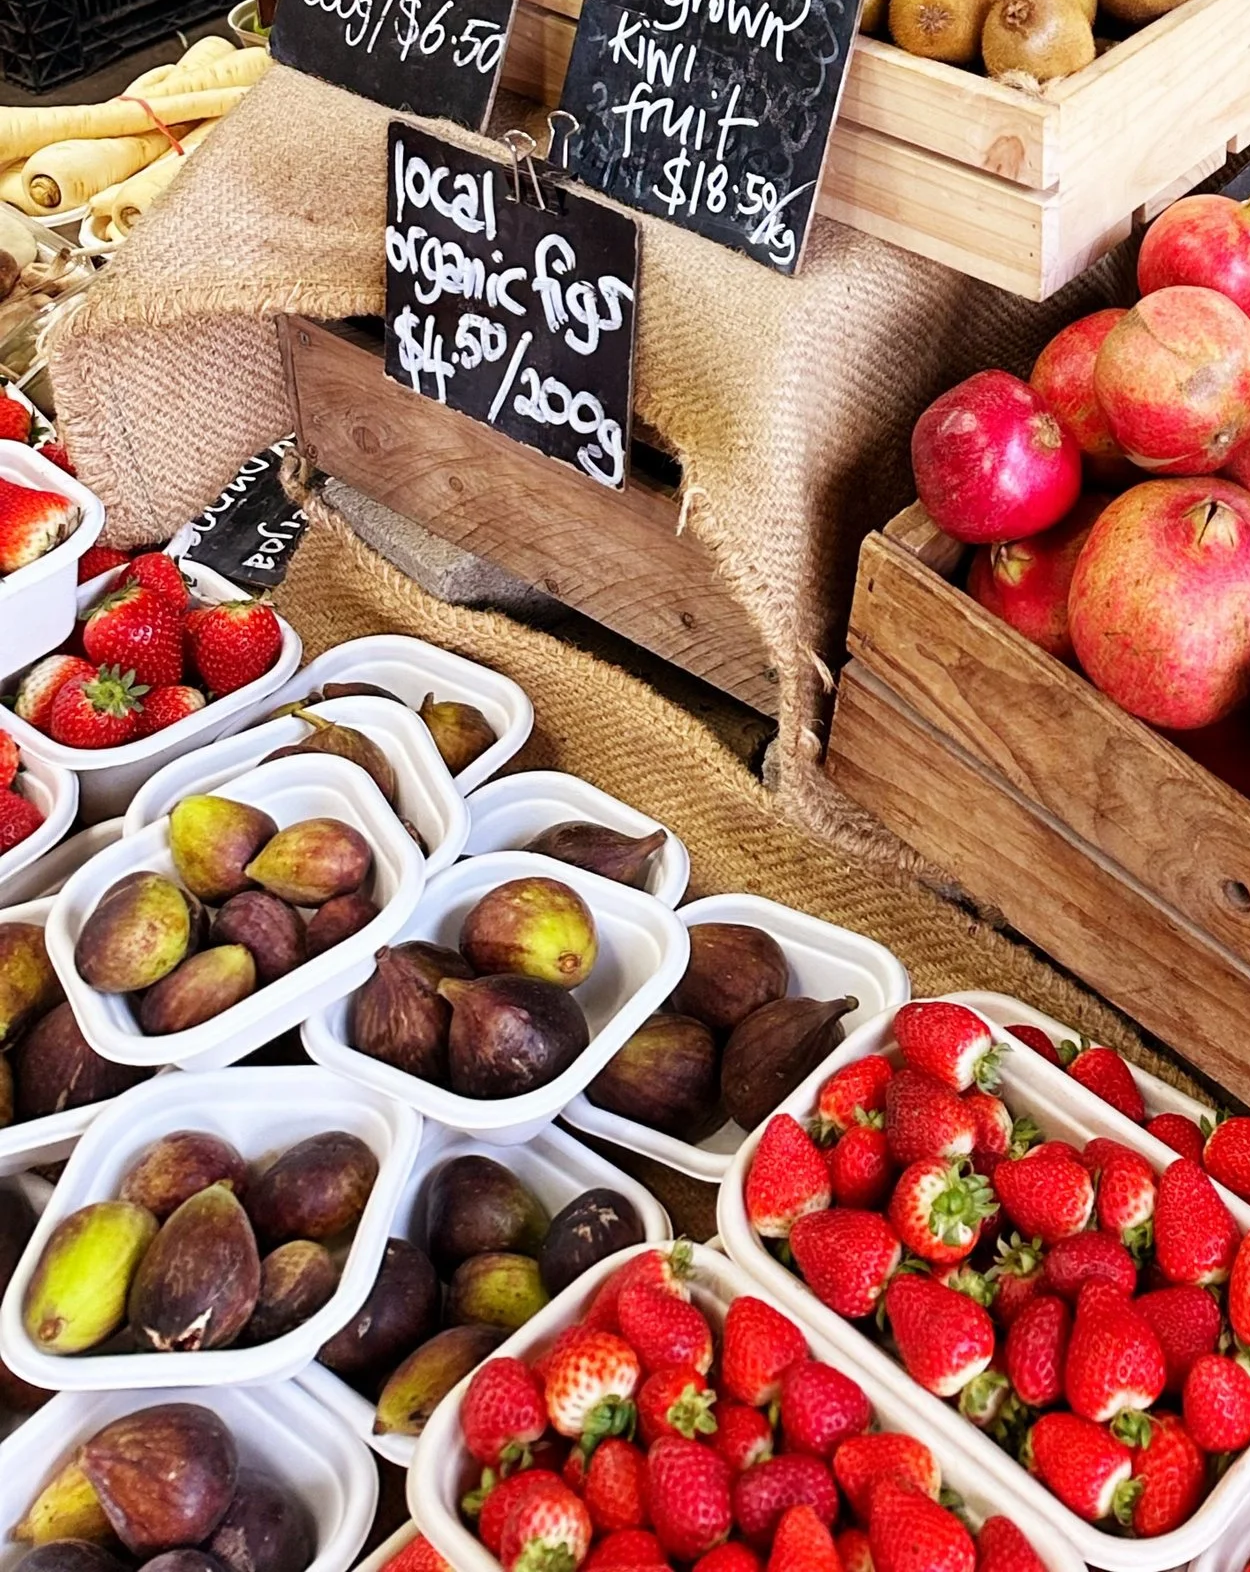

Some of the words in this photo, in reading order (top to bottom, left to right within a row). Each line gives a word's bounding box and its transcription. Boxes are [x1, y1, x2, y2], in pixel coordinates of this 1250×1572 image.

[608, 12, 695, 86] kiwi
[611, 87, 758, 161] fruit
[395, 140, 496, 241] local
[385, 226, 529, 316] organic
[533, 233, 635, 355] figs
